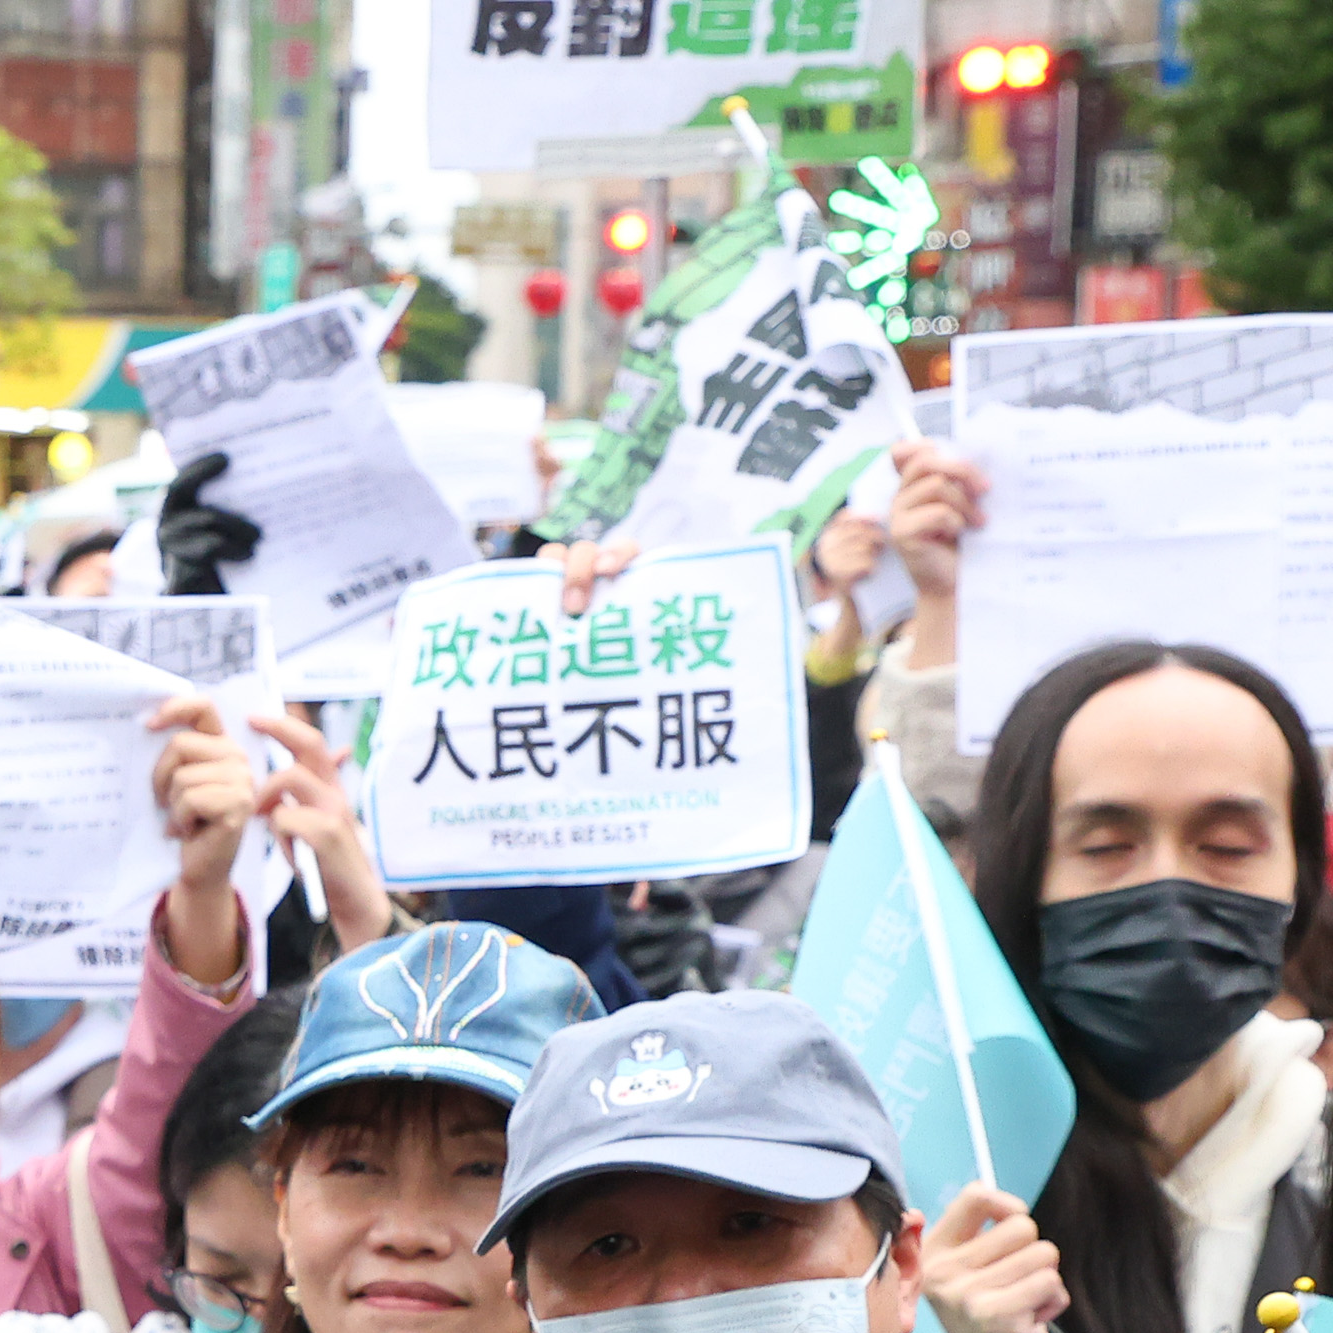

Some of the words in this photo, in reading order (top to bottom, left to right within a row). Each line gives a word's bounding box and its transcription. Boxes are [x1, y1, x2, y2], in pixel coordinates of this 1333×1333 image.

[412, 594, 734, 688] 政治追殺
[413, 690, 738, 784] 人民不服
